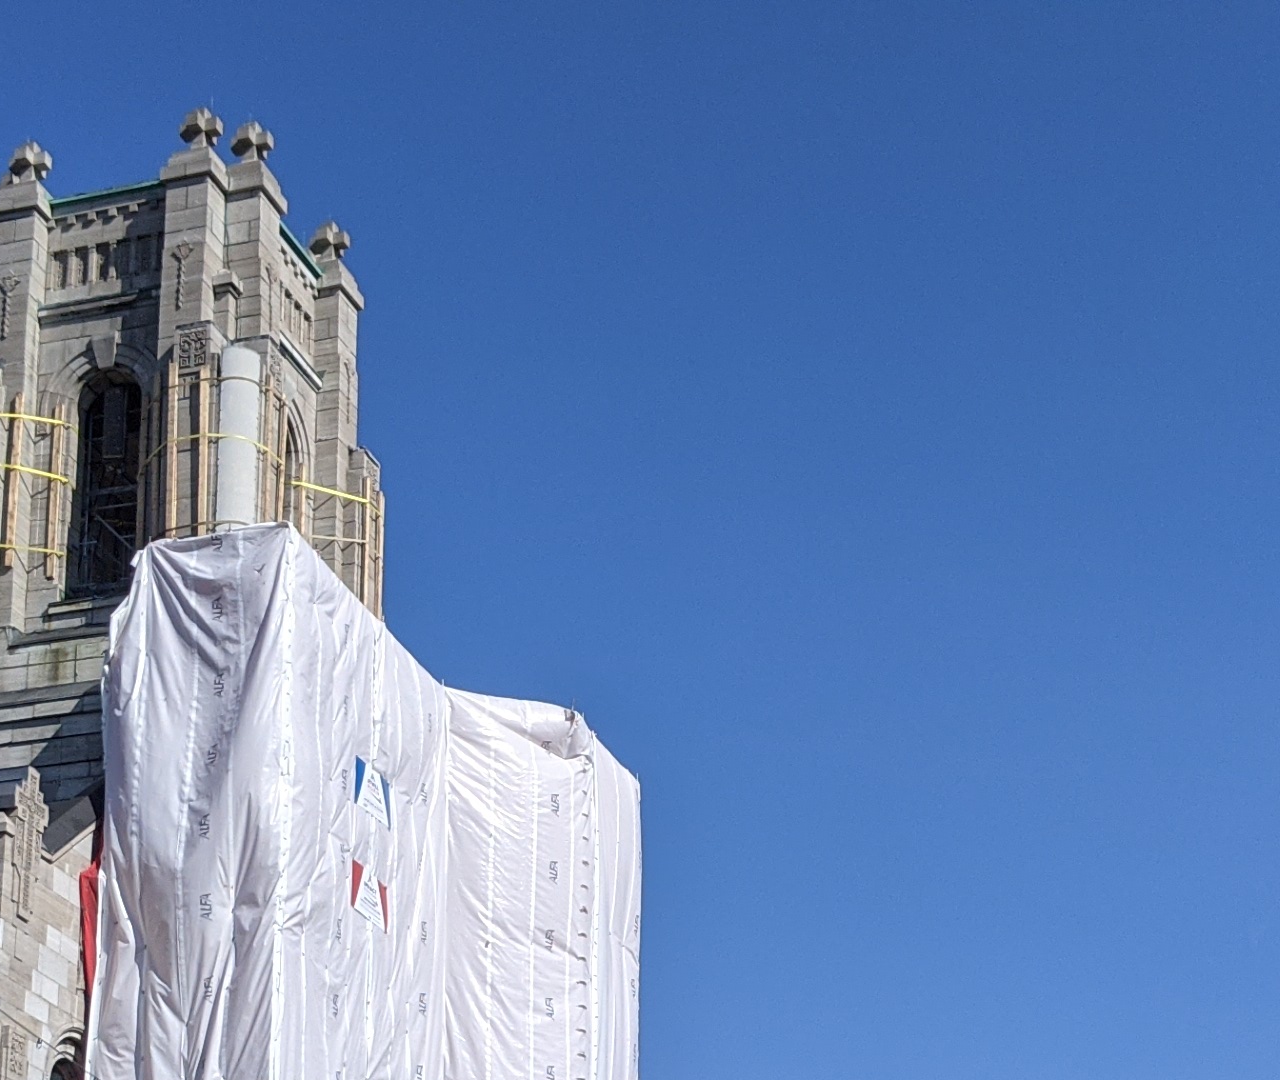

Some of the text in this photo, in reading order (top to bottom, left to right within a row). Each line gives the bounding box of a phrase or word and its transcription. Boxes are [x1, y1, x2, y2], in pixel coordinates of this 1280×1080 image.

[212, 596, 223, 622] ALFA
[214, 672, 224, 697] ALFA
[207, 743, 218, 767] ALFA
[551, 794, 559, 817] ALFA
[199, 813, 210, 839] ALFA
[549, 861, 558, 885] ALFA
[200, 893, 213, 921] ALFA
[545, 929, 555, 951] ALFA
[204, 974, 214, 1003] ALFA
[545, 998, 553, 1021] ALFA
